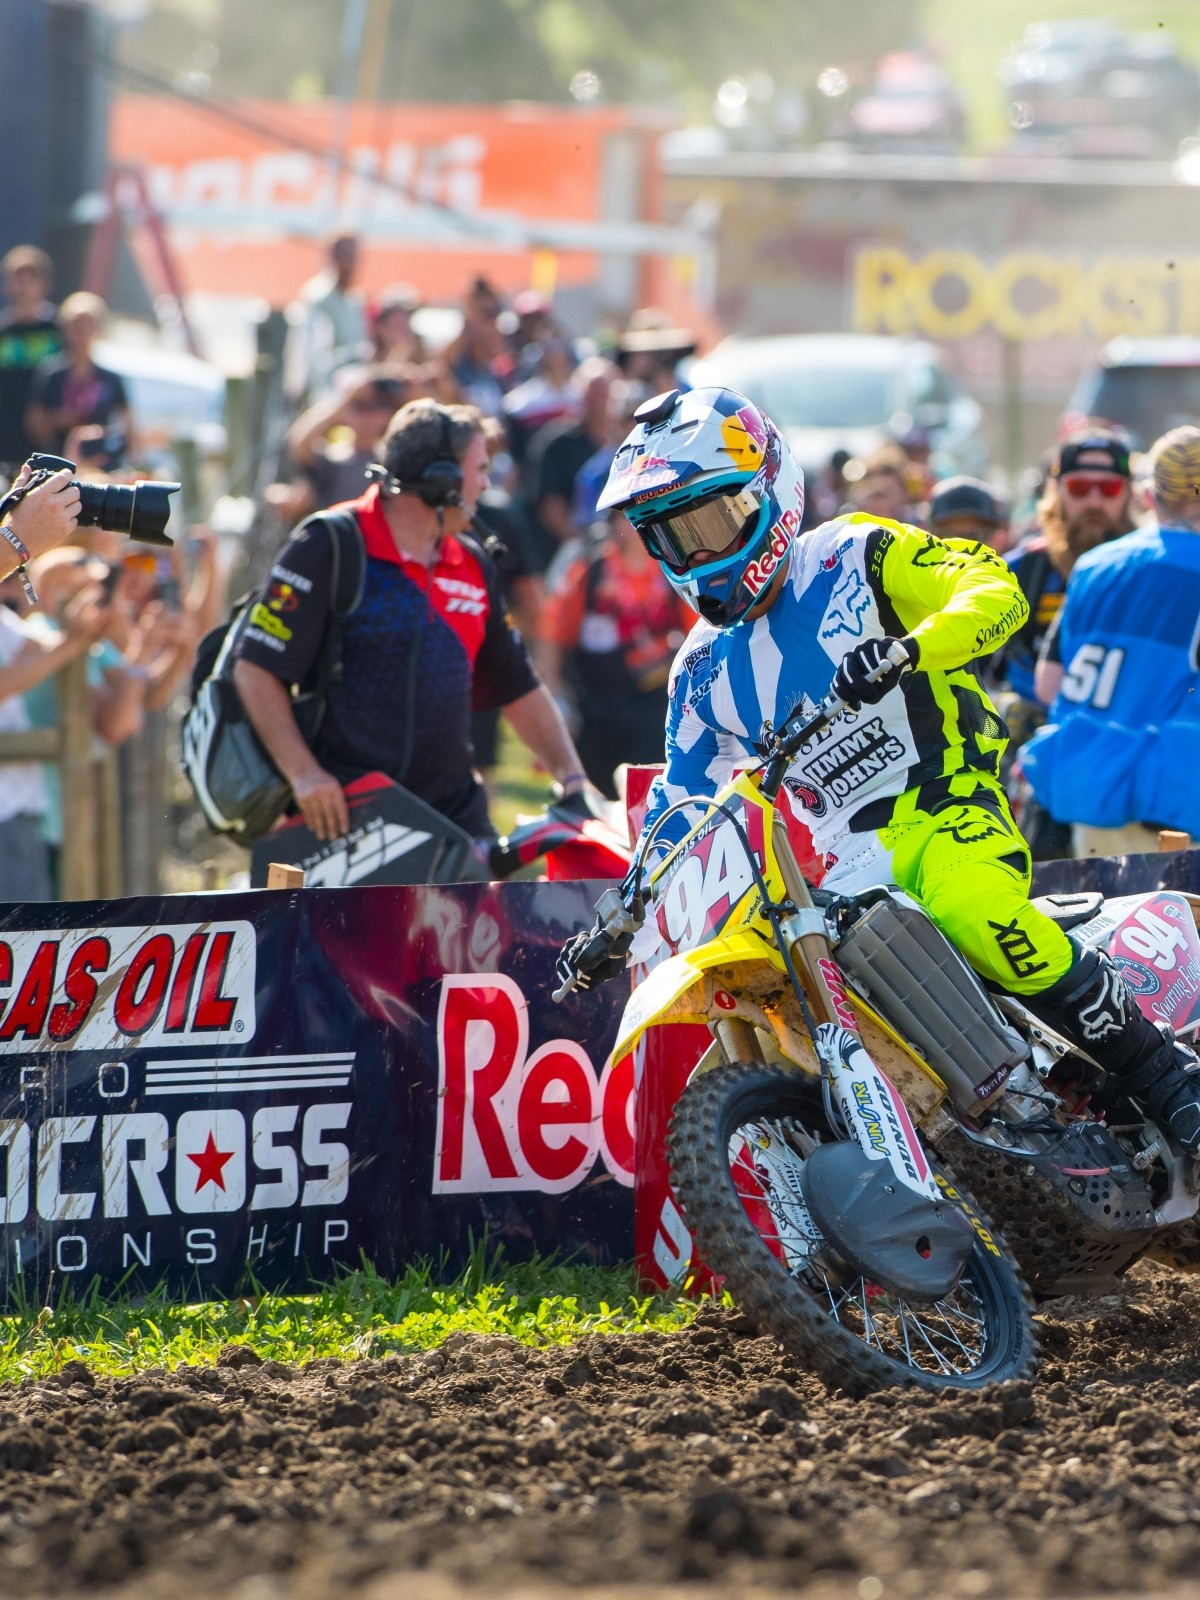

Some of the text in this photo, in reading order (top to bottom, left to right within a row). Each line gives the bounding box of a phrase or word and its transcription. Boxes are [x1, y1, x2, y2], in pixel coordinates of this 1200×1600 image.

[742, 521, 791, 598] Red
[1061, 643, 1125, 709] 51
[804, 720, 886, 787] JIMMY
[824, 737, 904, 807] JOHN'S
[664, 805, 755, 951] 94
[668, 820, 715, 877] LUCAS OIL
[987, 918, 1050, 979] FOX
[1120, 906, 1190, 971] 94
[113, 930, 238, 1038] OIL
[1151, 983, 1187, 1023] Soaring
[978, 1066, 1010, 1101] Twin Air
[872, 1075, 920, 1183] DUNLOP
